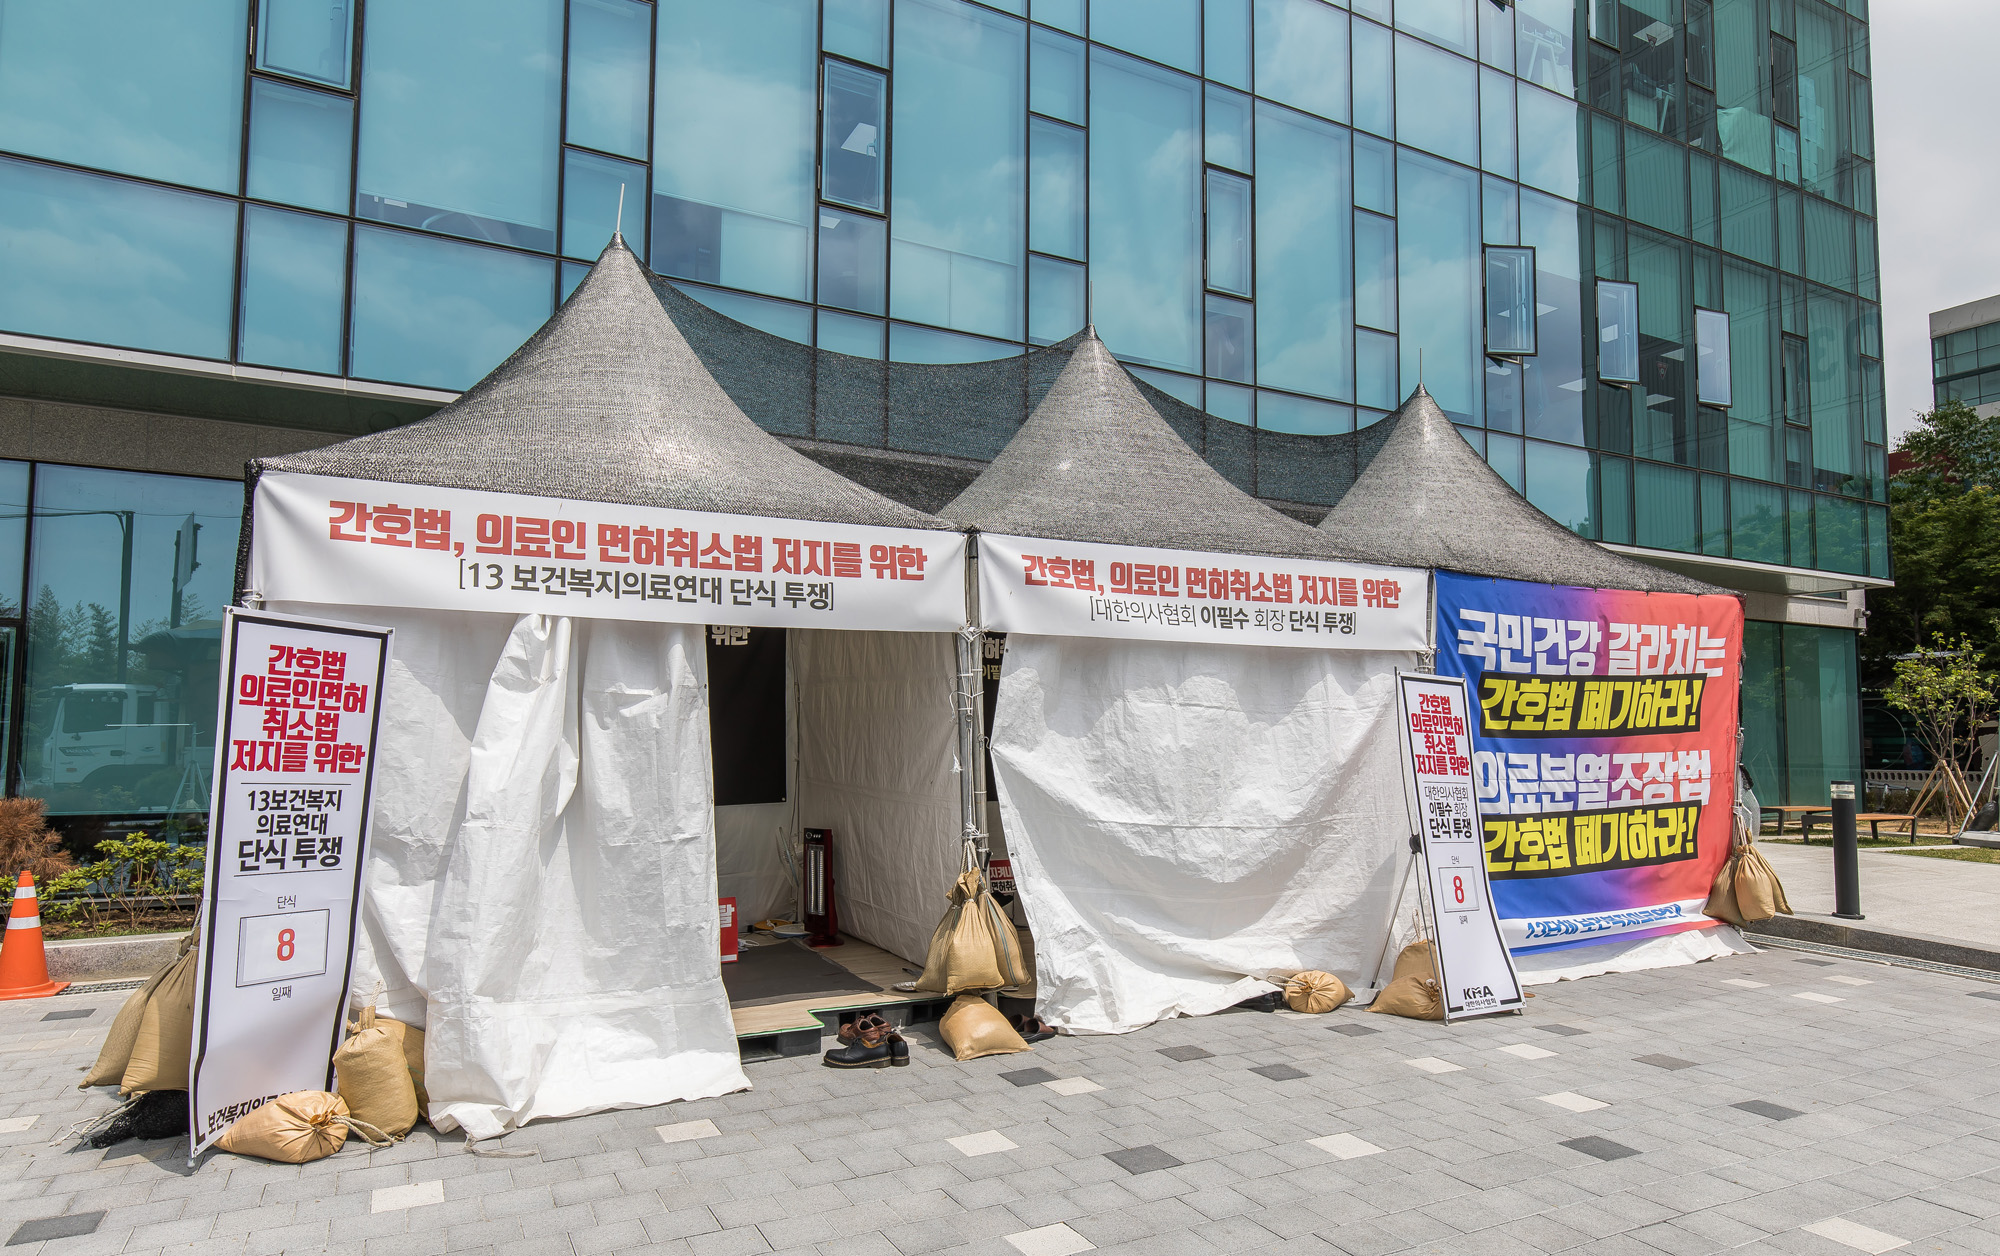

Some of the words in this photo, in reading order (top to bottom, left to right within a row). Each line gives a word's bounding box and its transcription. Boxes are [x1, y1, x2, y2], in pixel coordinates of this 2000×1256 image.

[329, 500, 465, 557] 간호법,
[476, 513, 587, 560] 의료인
[597, 523, 763, 573] 면허취소법
[772, 537, 863, 579] 저지를
[869, 544, 928, 581] 위한
[459, 559, 504, 590] [13
[511, 564, 723, 605] 보건복지의료연대
[730, 579, 777, 608] 단식
[782, 581, 834, 611] 투쟁]
[1021, 554, 1105, 596] 간호법,
[1110, 562, 1180, 598] 의료인
[1186, 567, 1293, 605] 면허취소법
[1298, 574, 1359, 607] 저지를
[1362, 578, 1402, 609] 위한
[1090, 596, 1197, 628] [대한의사협회
[1200, 605, 1250, 629] 이필수
[1254, 608, 1286, 632] 회장
[1289, 610, 1319, 633] 단식
[1323, 611, 1357, 635] 투쟁]
[1457, 608, 1603, 677] 국민건강
[1608, 622, 1727, 678] 갈라치는
[268, 644, 348, 682] 간호법
[238, 673, 369, 713] 의료인면허
[1418, 693, 1452, 716] 간호법
[1481, 678, 1577, 731] 간호법
[1577, 678, 1704, 731] 폐기하라!
[262, 707, 341, 743] 취소법
[1410, 712, 1465, 737] 의료인면허
[230, 739, 309, 773] 저지를
[313, 742, 366, 774] 위한
[1424, 733, 1458, 756] 취소법
[1414, 754, 1449, 776] 저지를
[1448, 755, 1470, 777] 위한
[1473, 750, 1712, 815] 의료분열조장법
[247, 789, 343, 812] 13보건복지
[1424, 785, 1469, 801] 대한의사협회
[1429, 802, 1453, 817] 이필수
[1453, 802, 1468, 818] 회장
[256, 813, 329, 837] 의료연대
[1428, 817, 1452, 839] 단식
[1452, 817, 1473, 839] 투쟁
[1483, 815, 1568, 873] 간호법
[1573, 806, 1699, 866] 폐기하라!
[237, 838, 287, 872] 단식
[292, 836, 343, 868] 투쟁
[276, 895, 297, 909] 단식
[1453, 875, 1465, 904] 8
[276, 928, 296, 962] 8
[271, 985, 293, 1001] 일째
[1462, 985, 1495, 1000] KMA
